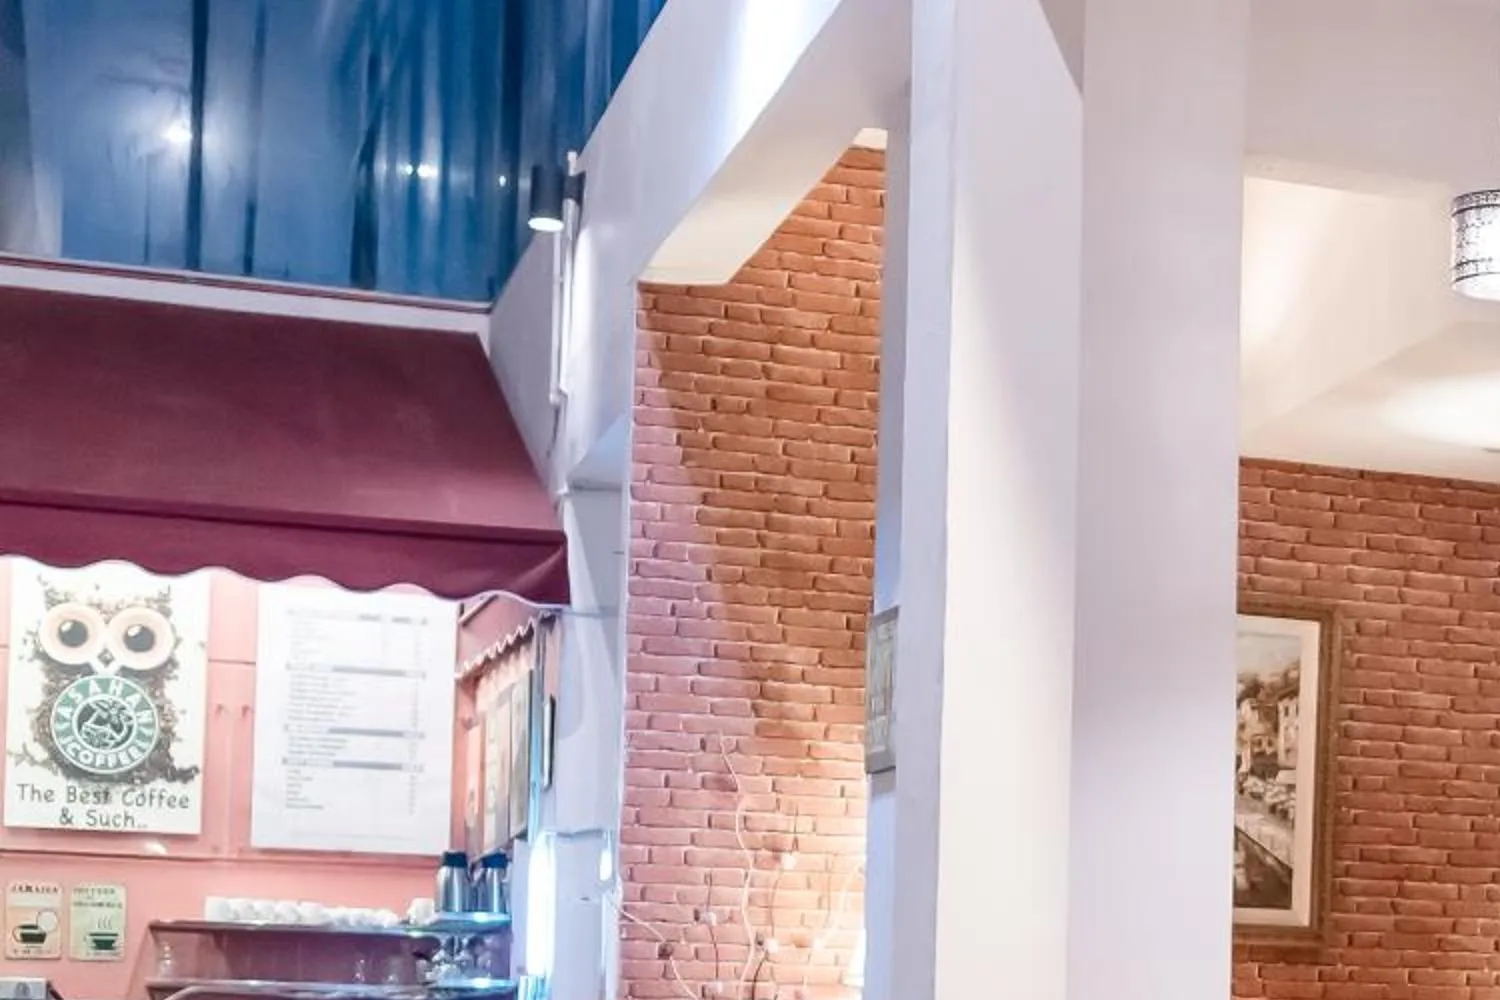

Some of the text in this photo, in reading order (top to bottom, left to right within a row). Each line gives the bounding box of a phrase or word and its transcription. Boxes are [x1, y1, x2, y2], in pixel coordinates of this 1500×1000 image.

[17, 783, 190, 809] The Best Coffee
[59, 807, 73, 825] &
